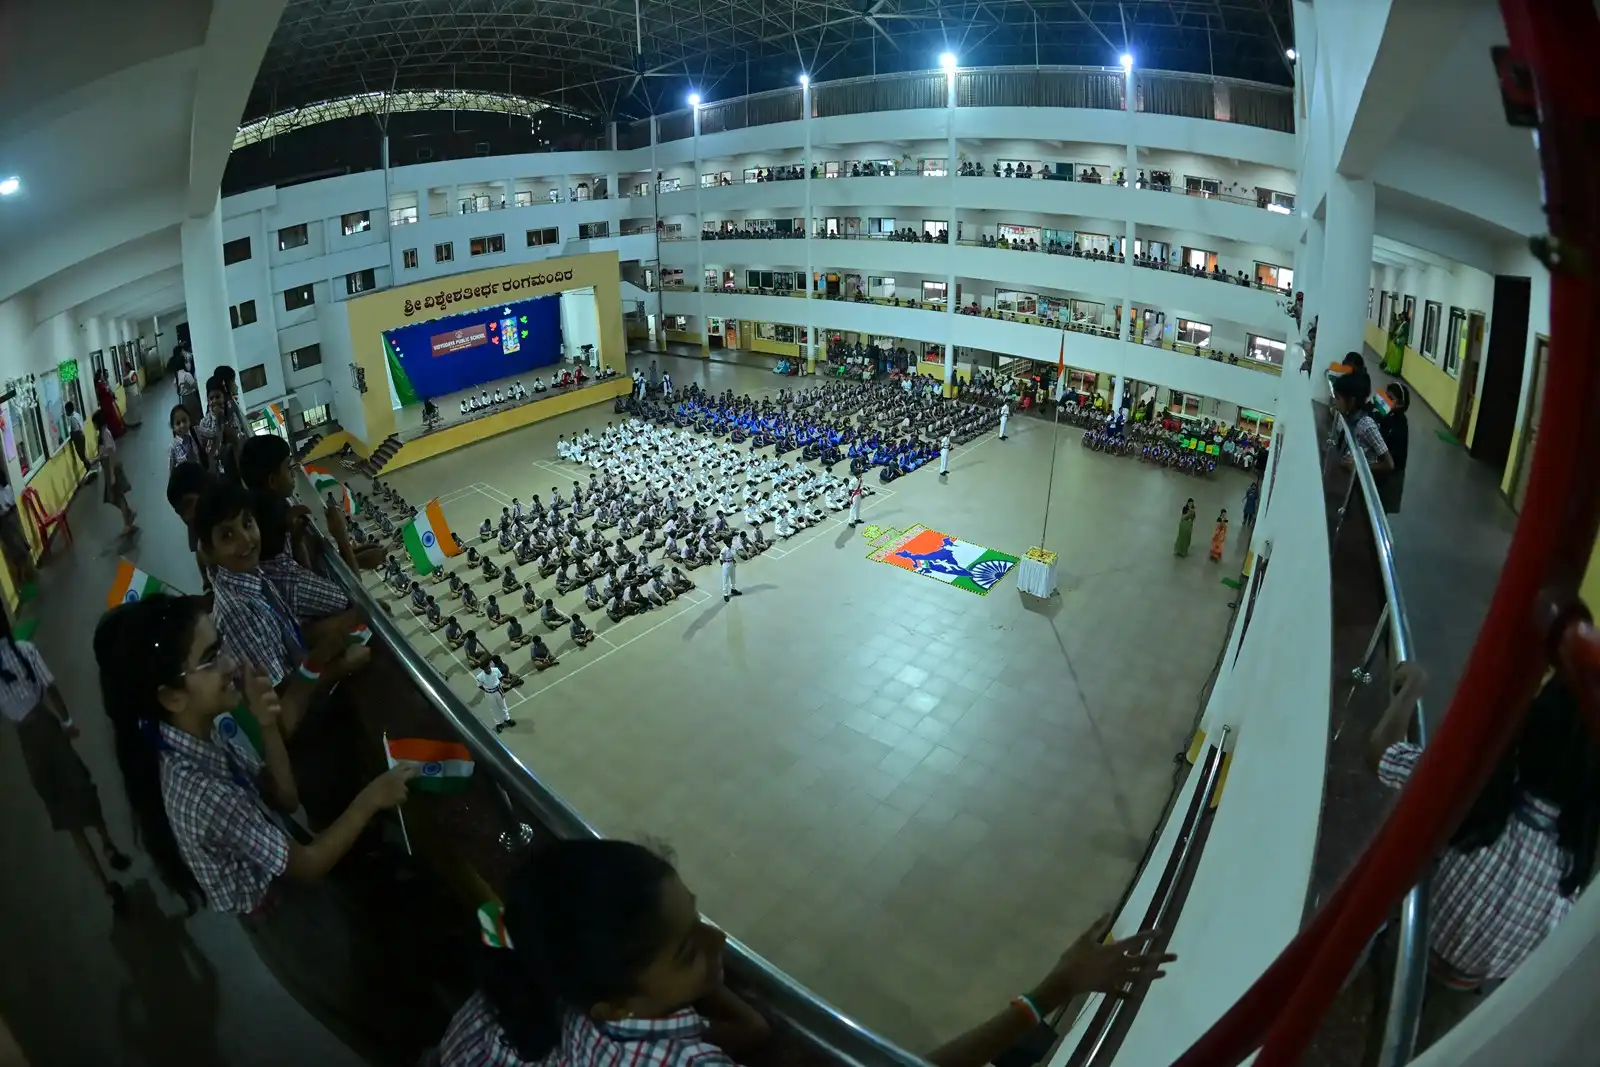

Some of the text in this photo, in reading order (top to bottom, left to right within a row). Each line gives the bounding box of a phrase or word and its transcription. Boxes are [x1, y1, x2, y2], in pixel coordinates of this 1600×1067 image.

[404, 268, 573, 317] ಶ್ರೀ ವಿಶ್ವೇಶತೀರ್ಥ ರಂಗಮಂದಿರ
[455, 335, 470, 345] PUBLIC
[470, 332, 486, 342] SCHOOL
